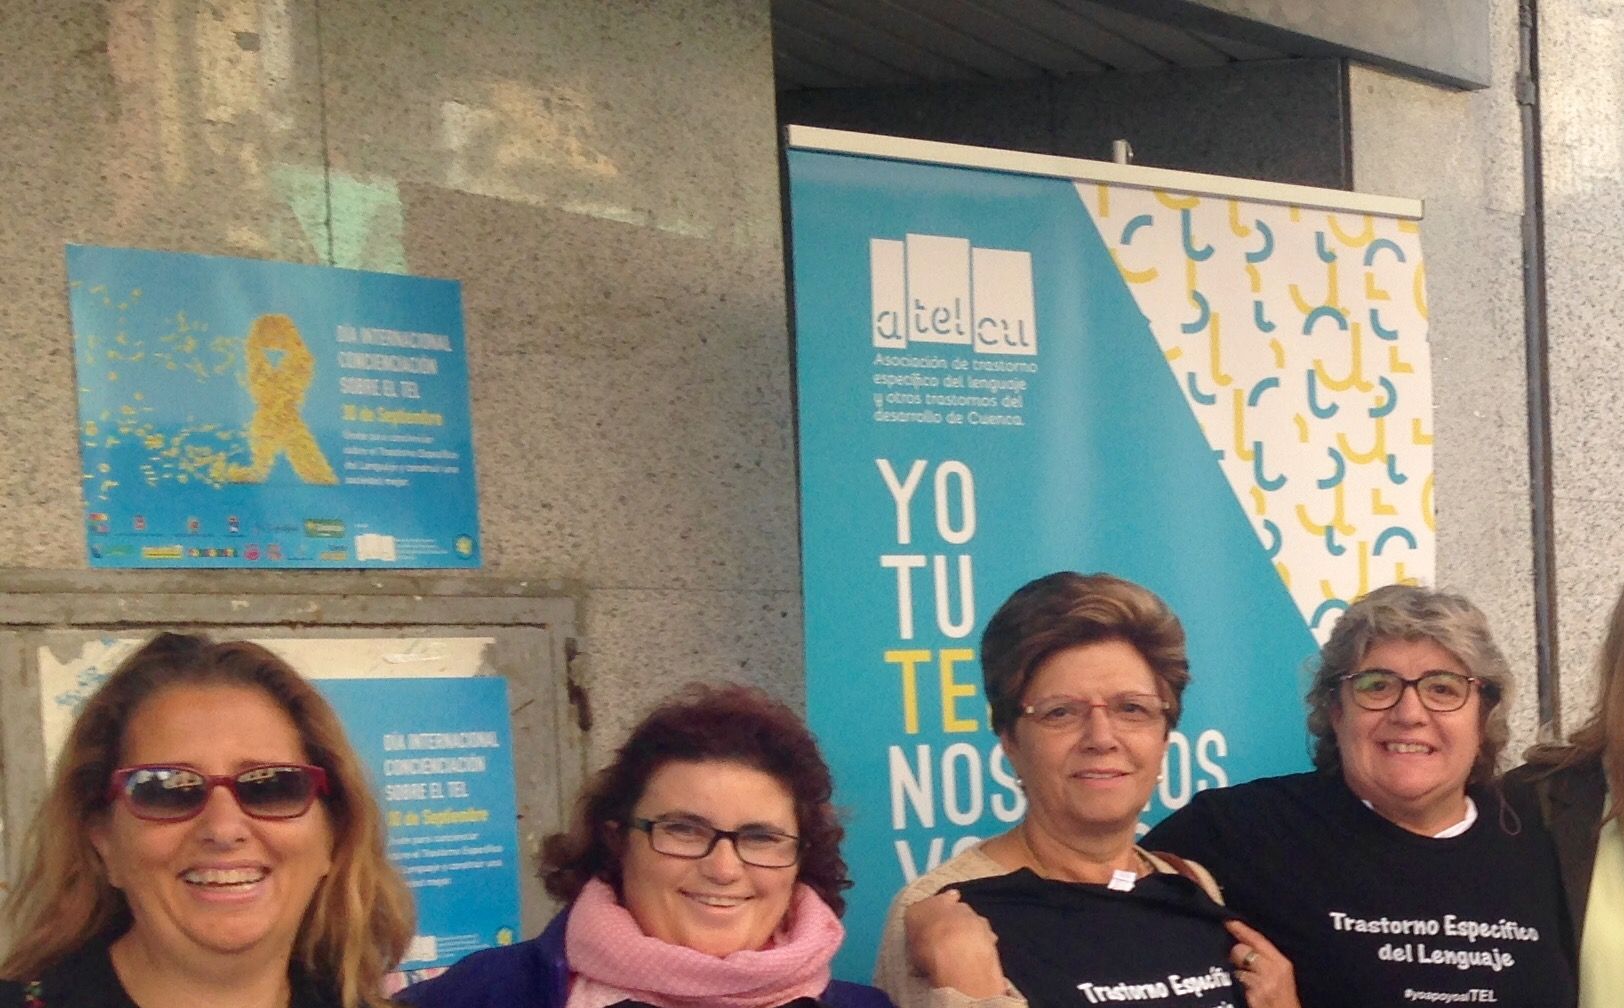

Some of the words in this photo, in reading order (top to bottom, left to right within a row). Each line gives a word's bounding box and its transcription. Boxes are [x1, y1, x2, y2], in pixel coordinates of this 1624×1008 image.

[873, 353, 947, 369] Asociación
[952, 357, 969, 370] de
[972, 360, 1038, 373] trastorno
[873, 373, 939, 389] específico
[943, 375, 964, 388] del
[967, 376, 1027, 394] lenguaje
[886, 392, 922, 405] otros
[925, 394, 997, 407] trastornos
[1001, 395, 1023, 408] del
[873, 408, 942, 424] desarrollo
[946, 411, 963, 424] de
[875, 458, 977, 546] YO
[880, 554, 976, 640] TU
[884, 648, 993, 735] TE
[407, 731, 500, 749] INTERNACIONAL
[1329, 911, 1440, 936] Trastorno
[1443, 914, 1540, 942] Específico
[1378, 943, 1412, 963] del
[1417, 943, 1515, 972] Lenguaje
[1076, 981, 1169, 1004] Trastorno
